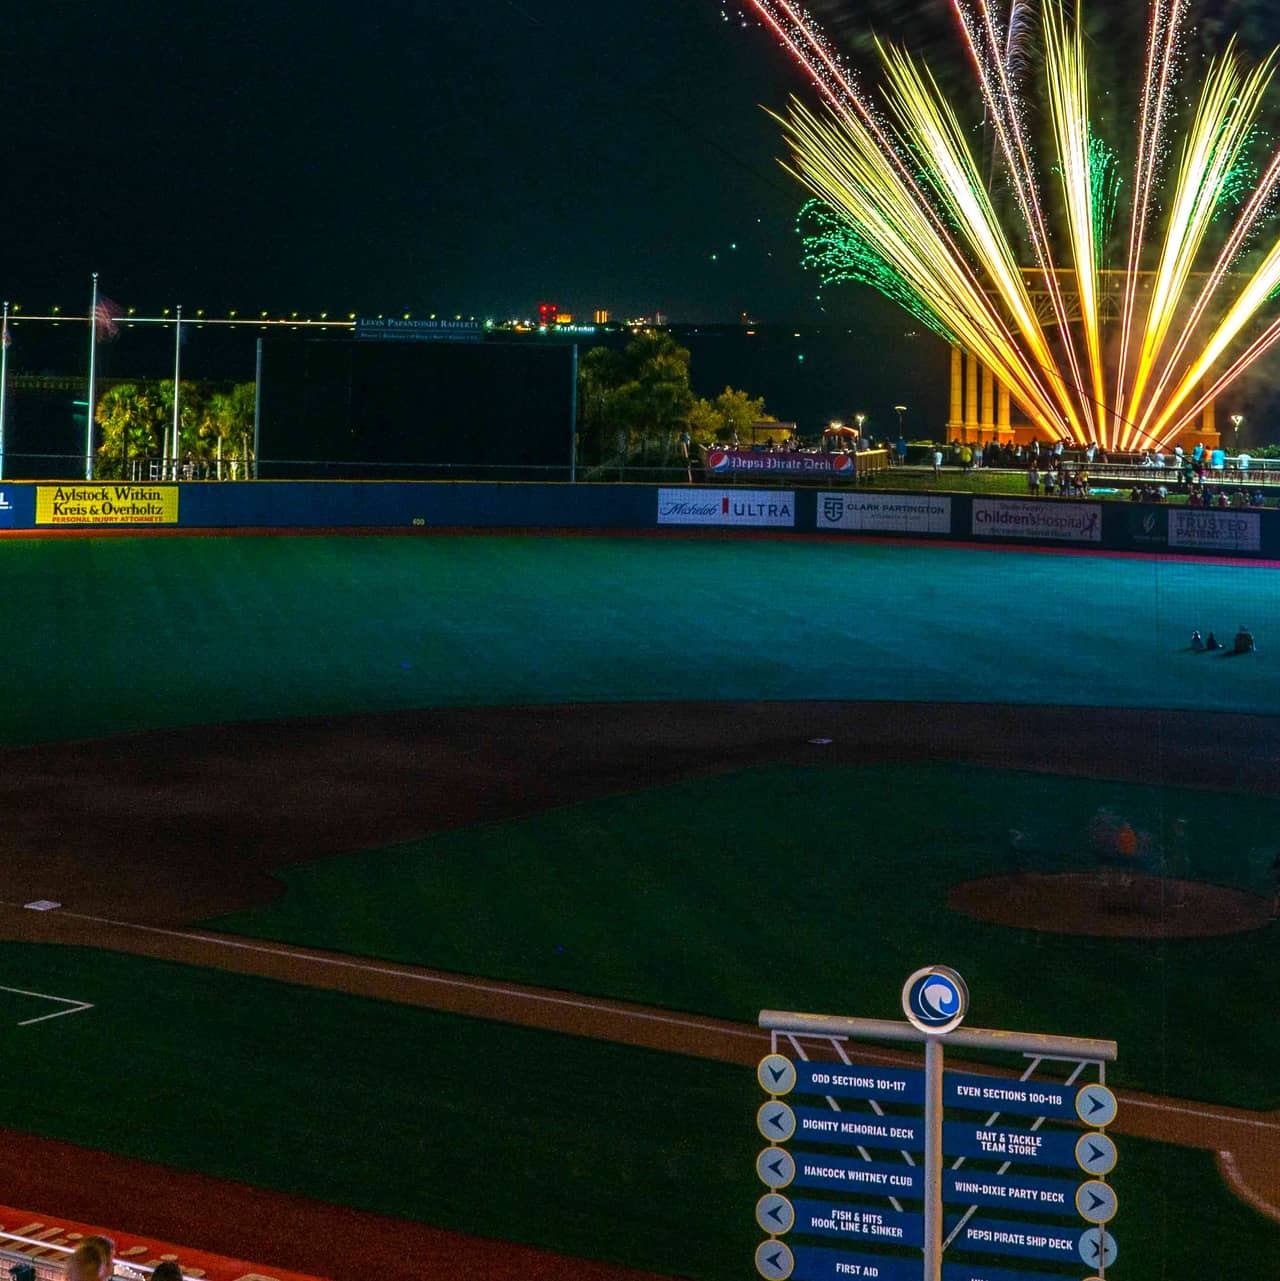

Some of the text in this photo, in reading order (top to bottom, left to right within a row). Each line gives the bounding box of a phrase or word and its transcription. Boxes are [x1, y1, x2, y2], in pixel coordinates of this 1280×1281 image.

[732, 457, 764, 470] Pepsi
[766, 457, 802, 470] Pirate
[53, 487, 113, 503] Aylstock,
[53, 502, 163, 516] Kreis & Overholtz
[663, 503, 791, 517] Michelob ULTRA
[847, 503, 945, 514] CLARK PARTINGTON
[975, 510, 1086, 529] Children's Hospital
[1176, 517, 1248, 532] TRUSTED
[812, 1073, 906, 1092] ODD SECTIONS 101-117
[957, 1085, 1063, 1105] EVEN SECTIONS 100-118
[803, 1119, 914, 1139] DIGNITY MEMORIAL DECK
[976, 1130, 1042, 1147] BAIT & TACKLE
[981, 1141, 1037, 1156] TEAM STORE
[804, 1165, 913, 1186] HANCOCK WHITNEY CLUB
[954, 1181, 1065, 1203] WINN-DIXIE PARTY DECK
[831, 1209, 883, 1225] FISH & HITS
[811, 1217, 903, 1238] HOOK, LINE & SINKER
[967, 1228, 1073, 1250] PEPSI PIRATE SHIP DECK
[836, 1262, 879, 1277] FIRST AID
